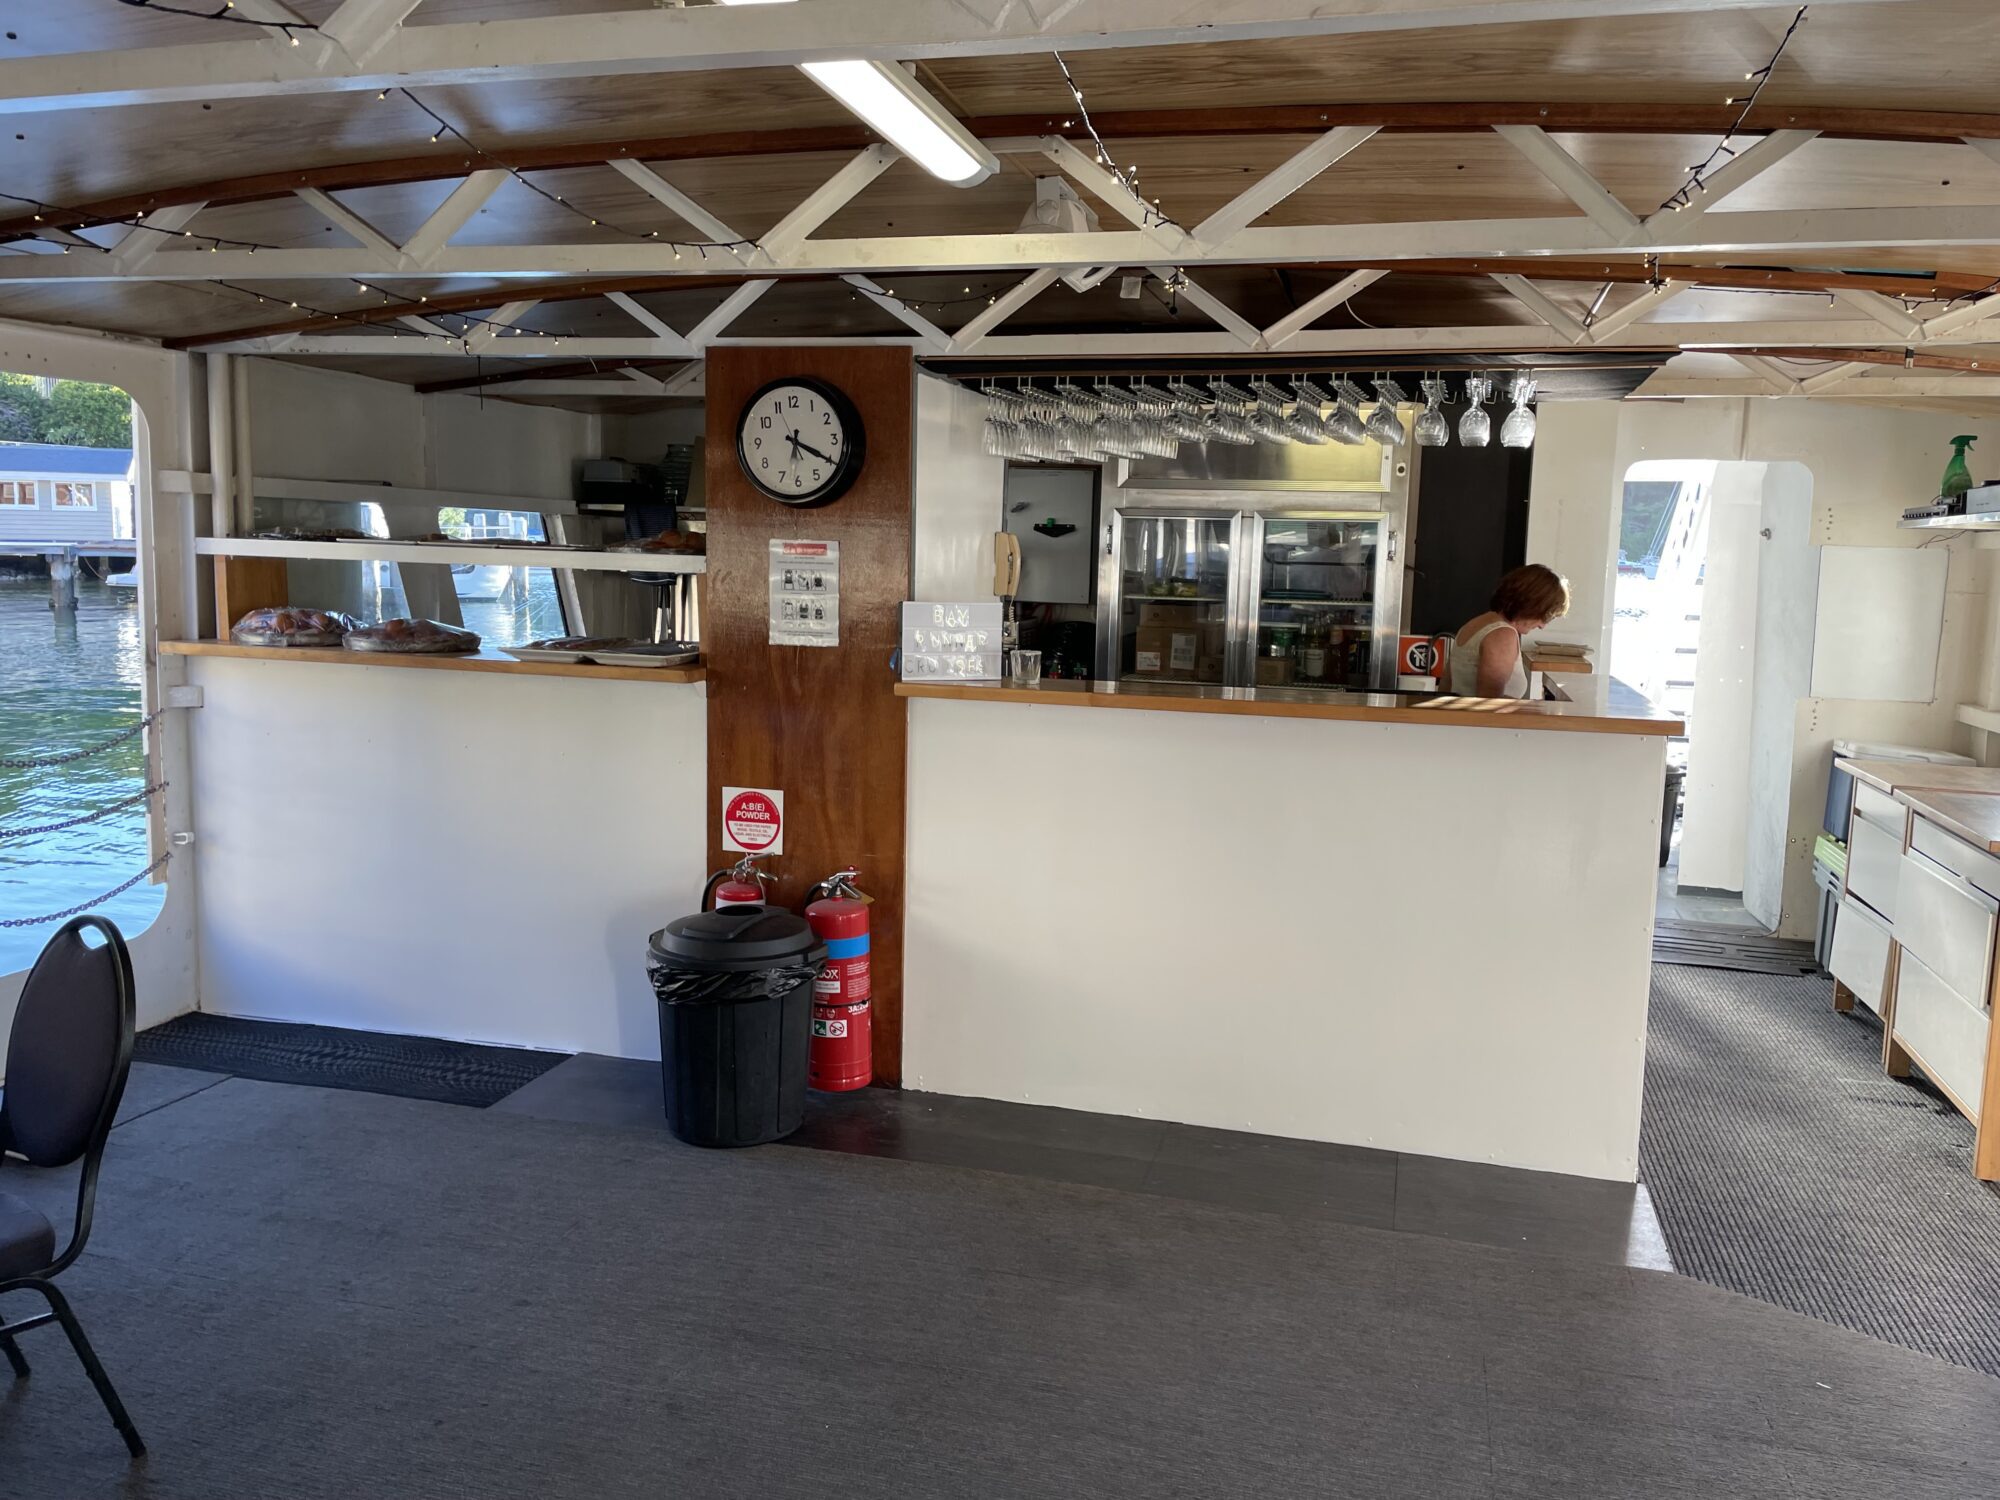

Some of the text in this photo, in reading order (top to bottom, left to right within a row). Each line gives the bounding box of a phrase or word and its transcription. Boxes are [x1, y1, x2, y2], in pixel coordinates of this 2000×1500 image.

[775, 402, 782, 414] 11
[788, 396, 799, 408] 12
[760, 417, 771, 429] 10
[823, 413, 831, 425] 2
[754, 438, 762, 450] 9
[830, 433, 838, 445] 3
[761, 457, 769, 469] 8
[825, 455, 832, 466] 4
[778, 471, 786, 483] 7
[795, 475, 802, 487] 6
[812, 469, 820, 481] 5
[933, 605, 969, 627] BAY
[736, 810, 770, 820] POWDER
